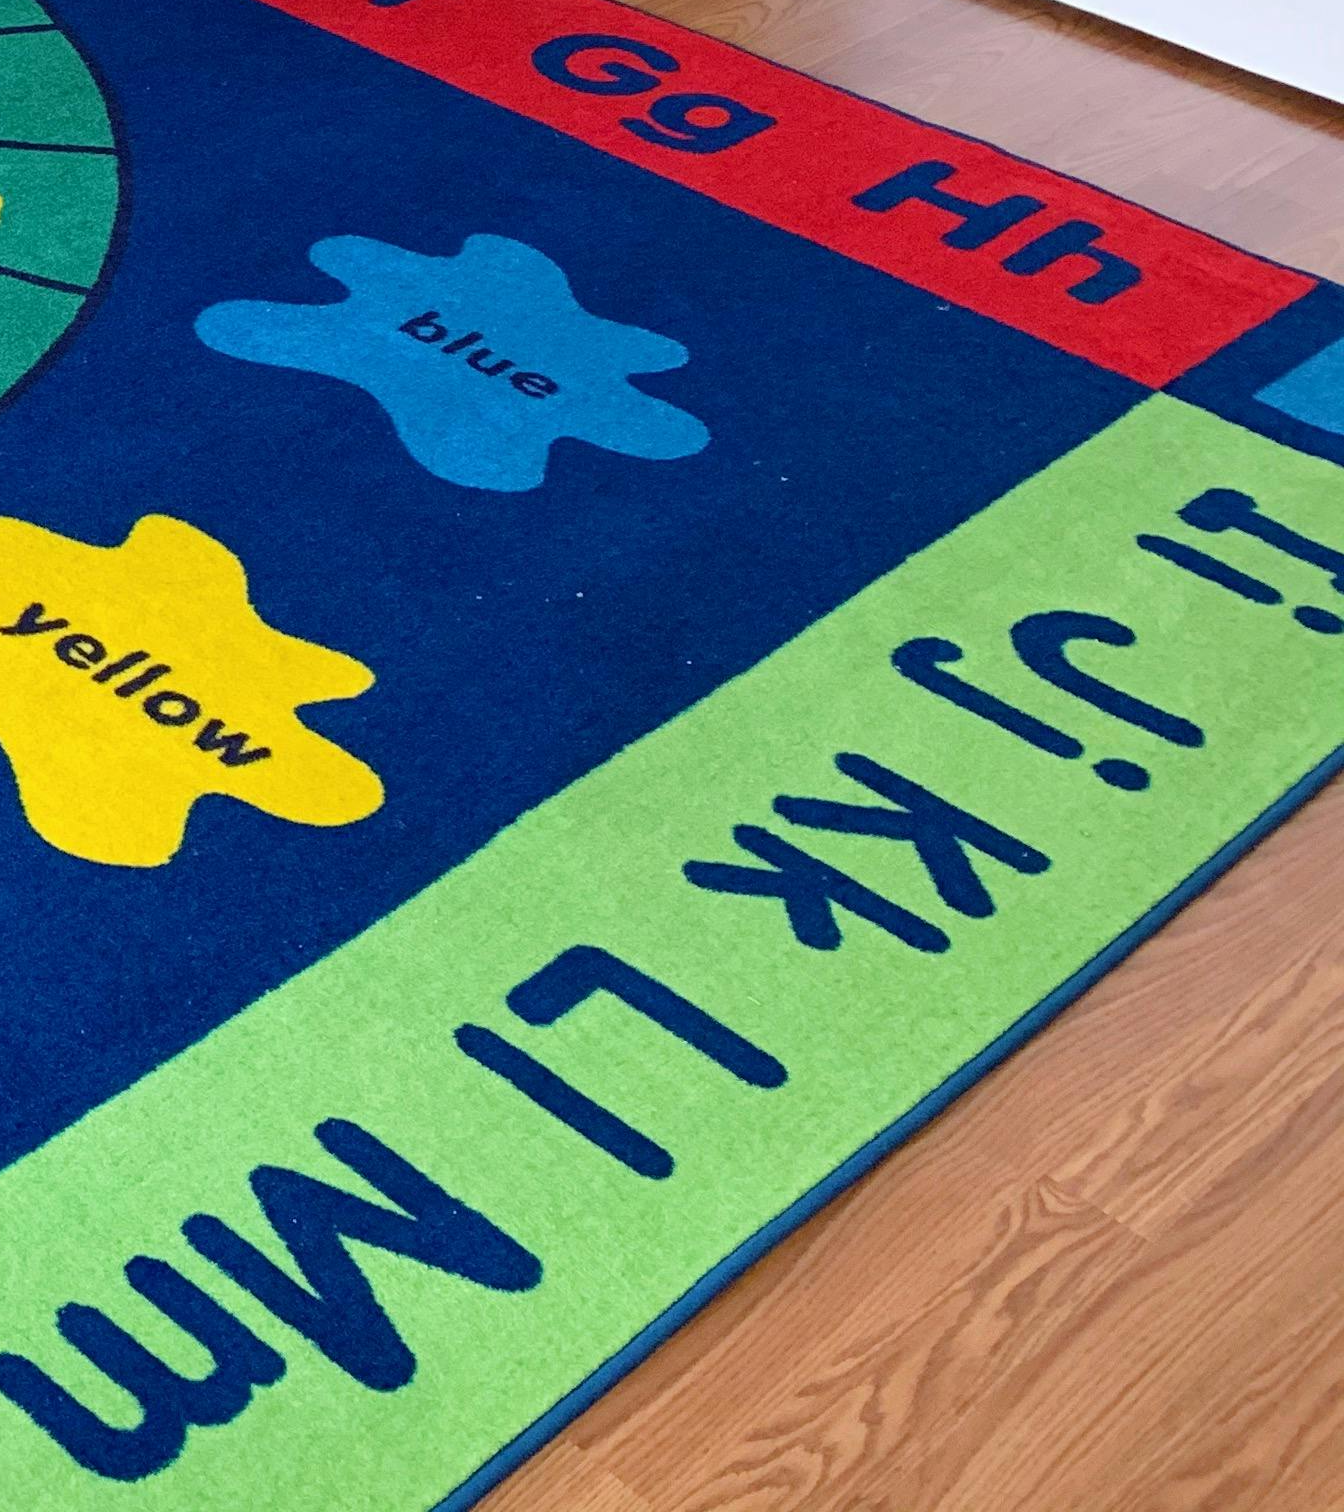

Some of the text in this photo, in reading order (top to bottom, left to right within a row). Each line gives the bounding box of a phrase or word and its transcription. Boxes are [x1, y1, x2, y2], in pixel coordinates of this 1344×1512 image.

[532, 34, 777, 154] Gg
[851, 160, 1141, 304] Hh
[400, 312, 557, 396] blue
[891, 611, 1204, 791] Jj
[682, 752, 1051, 953] Kk
[453, 945, 788, 1180] Ll
